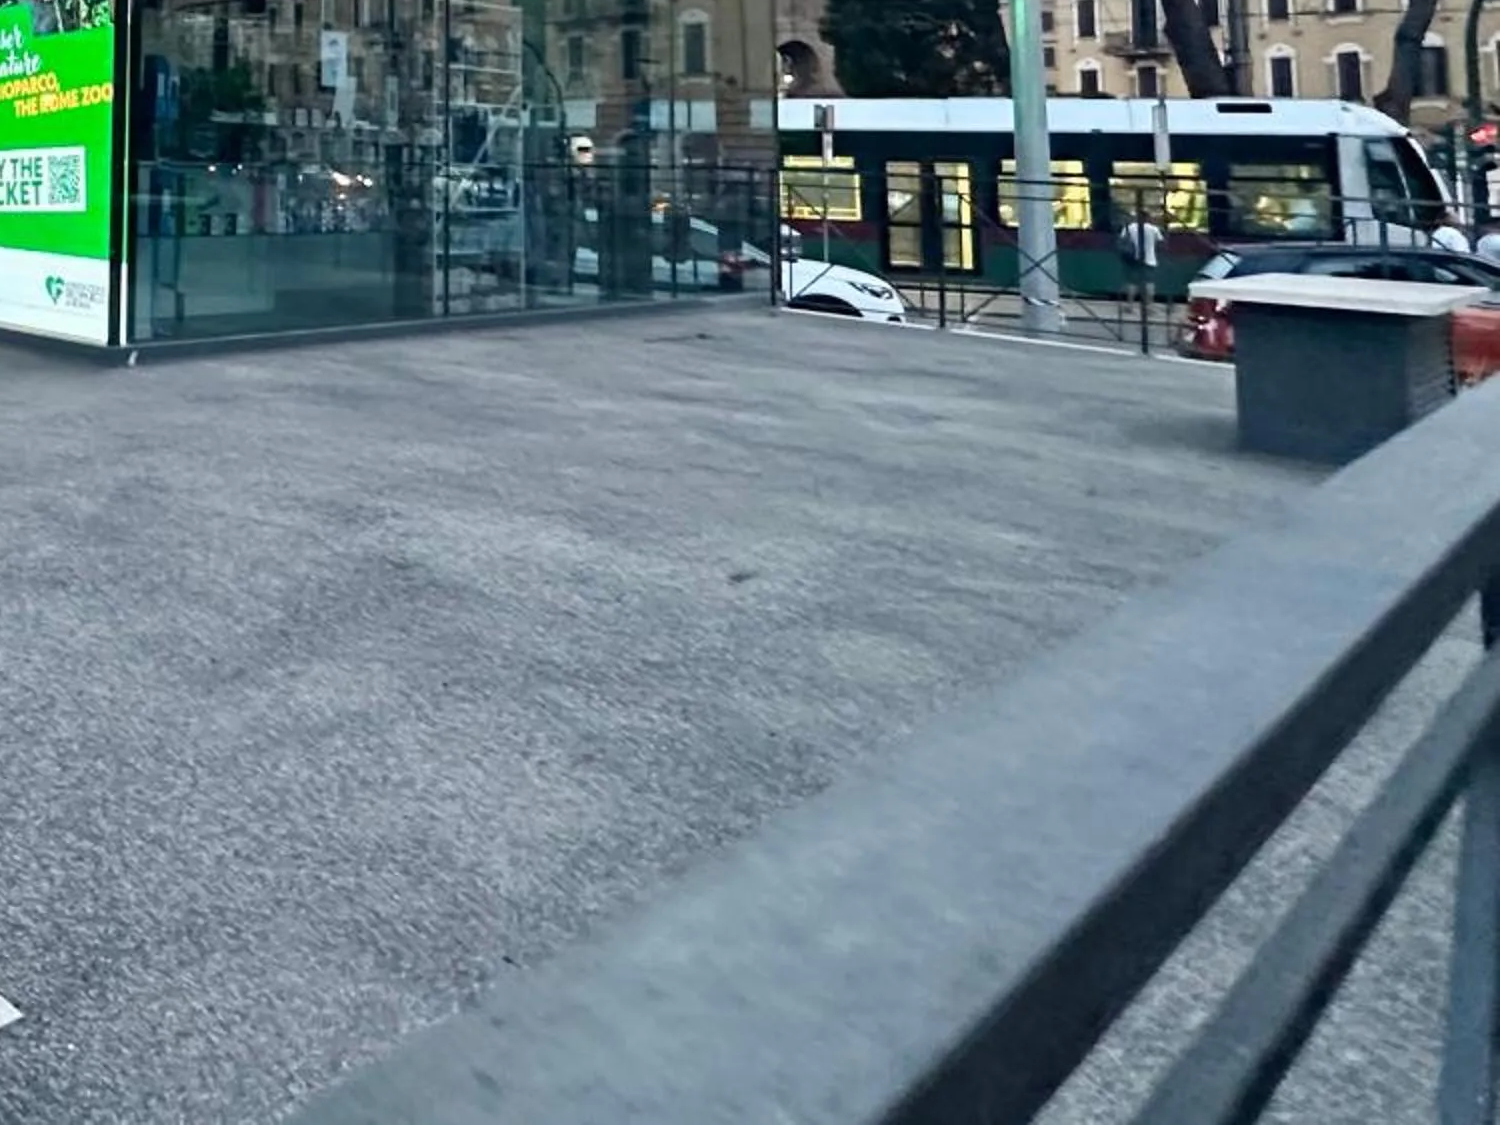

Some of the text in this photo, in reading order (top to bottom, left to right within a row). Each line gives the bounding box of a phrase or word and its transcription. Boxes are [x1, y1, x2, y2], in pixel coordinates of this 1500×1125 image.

[14, 82, 114, 118] THE ROME ZOO
[9, 156, 43, 180] THE
